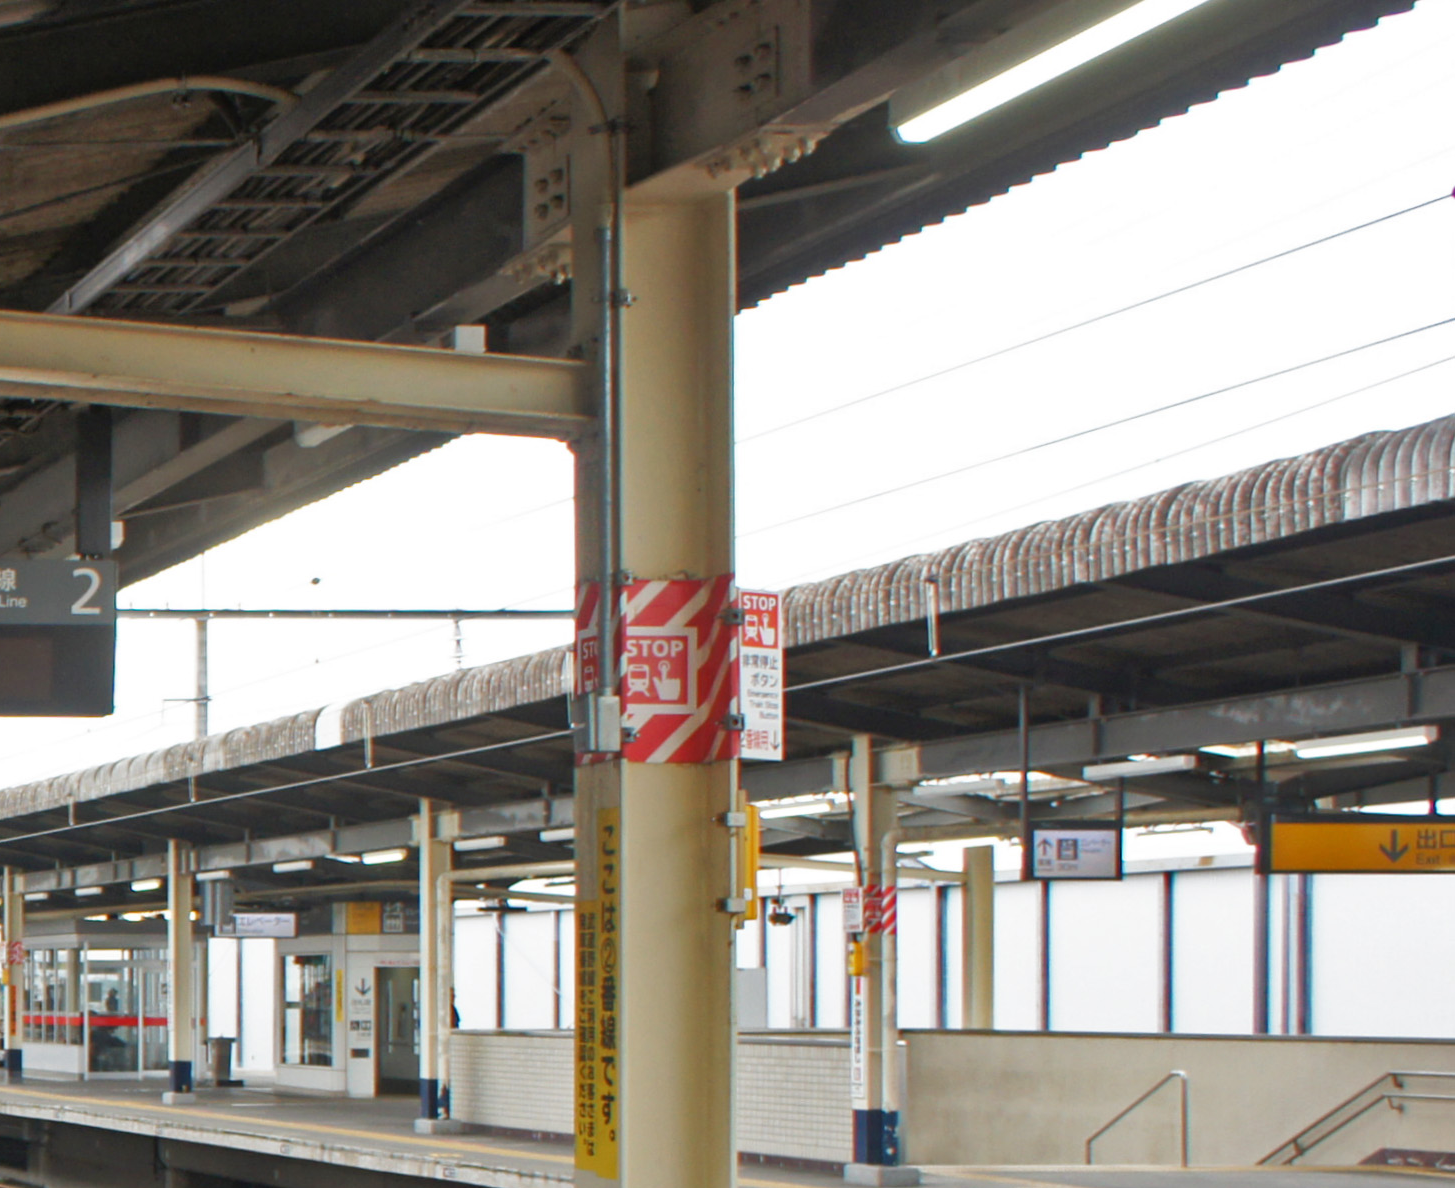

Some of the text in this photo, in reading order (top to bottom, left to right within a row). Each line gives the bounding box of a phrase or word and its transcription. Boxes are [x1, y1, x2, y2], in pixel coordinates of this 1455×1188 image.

[70, 567, 102, 615] 2
[742, 594, 777, 611] STOP
[625, 640, 684, 657] STOP
[750, 672, 779, 688] ボタン
